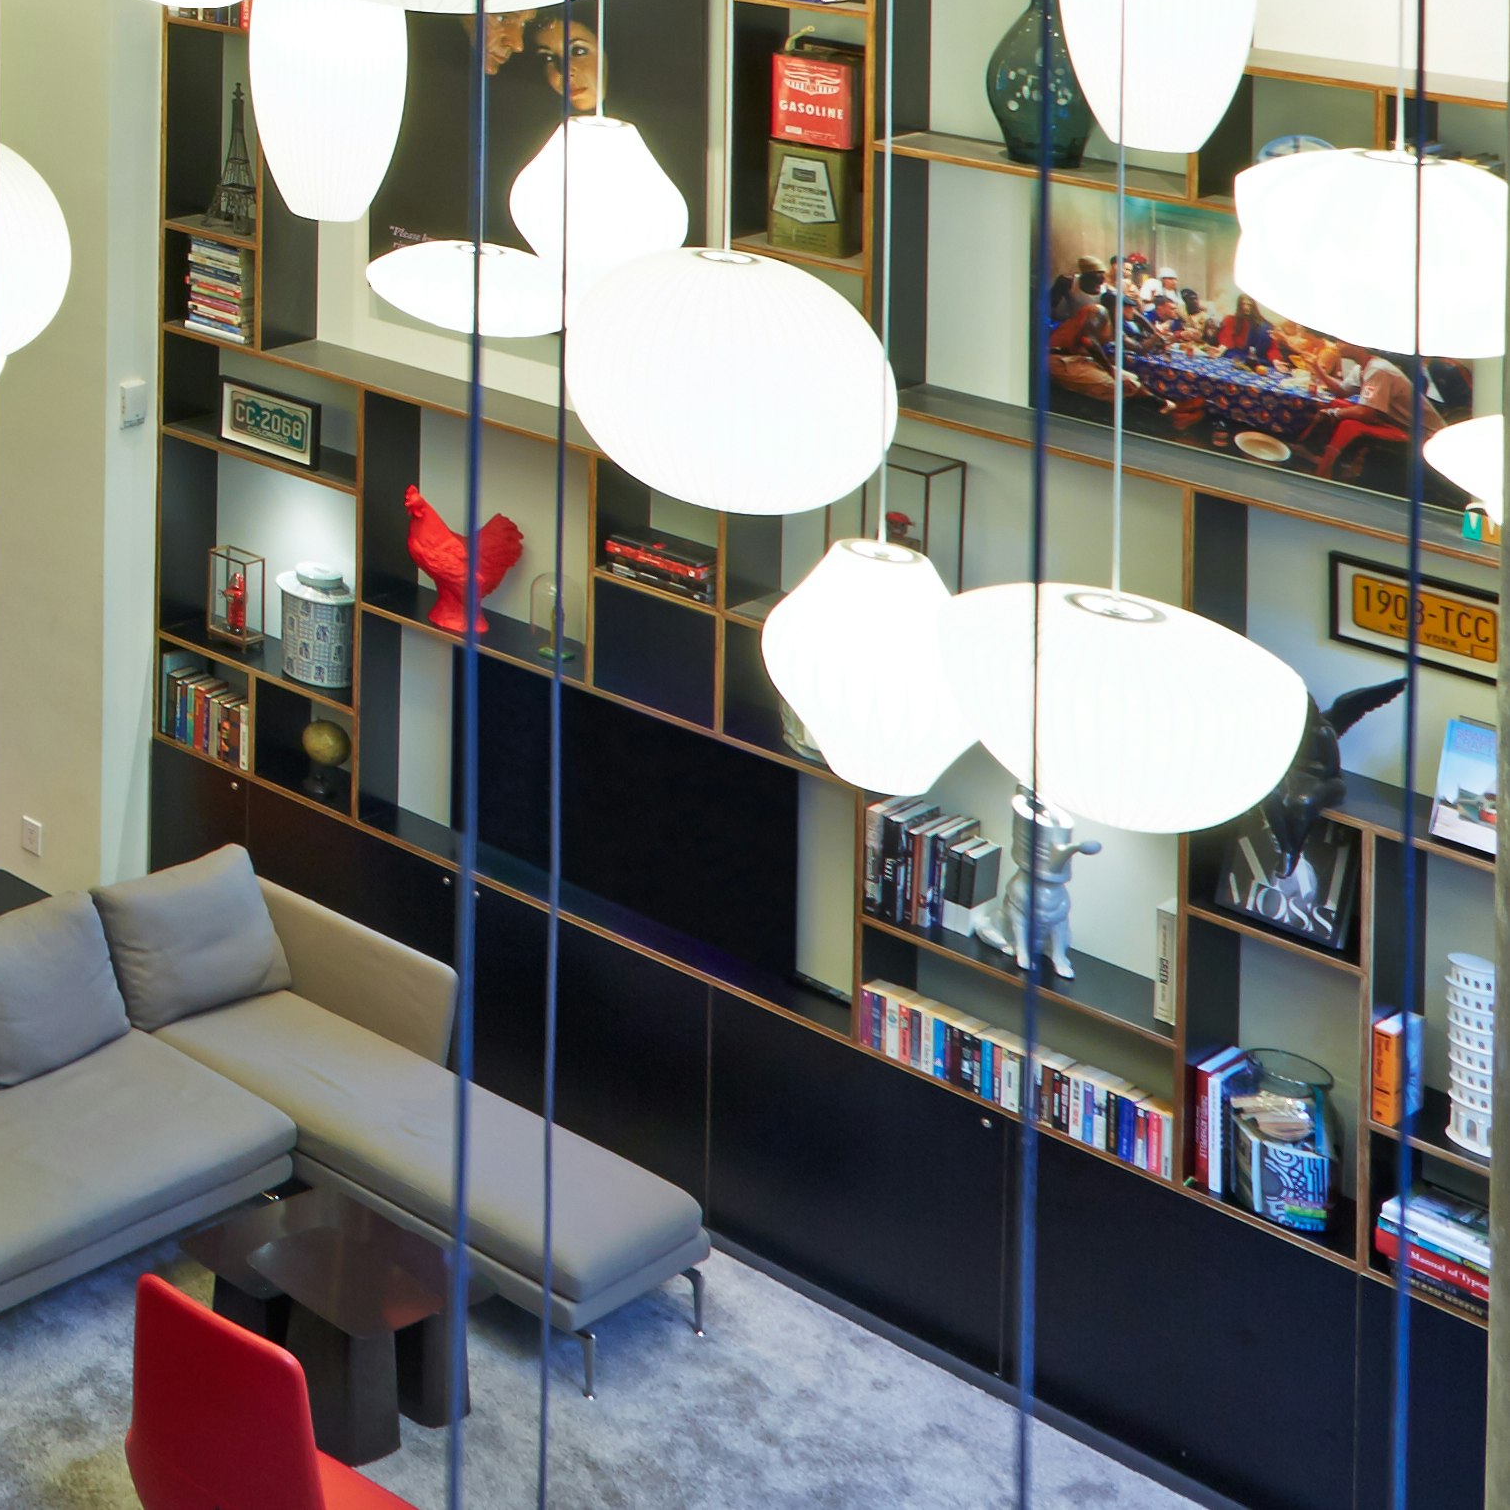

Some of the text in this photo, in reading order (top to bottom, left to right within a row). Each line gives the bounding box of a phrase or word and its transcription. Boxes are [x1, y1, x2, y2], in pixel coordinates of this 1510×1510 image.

[779, 99, 844, 120] GASOLINE
[1410, 1251, 1446, 1273] Manual
[1448, 1267, 1458, 1278] of
